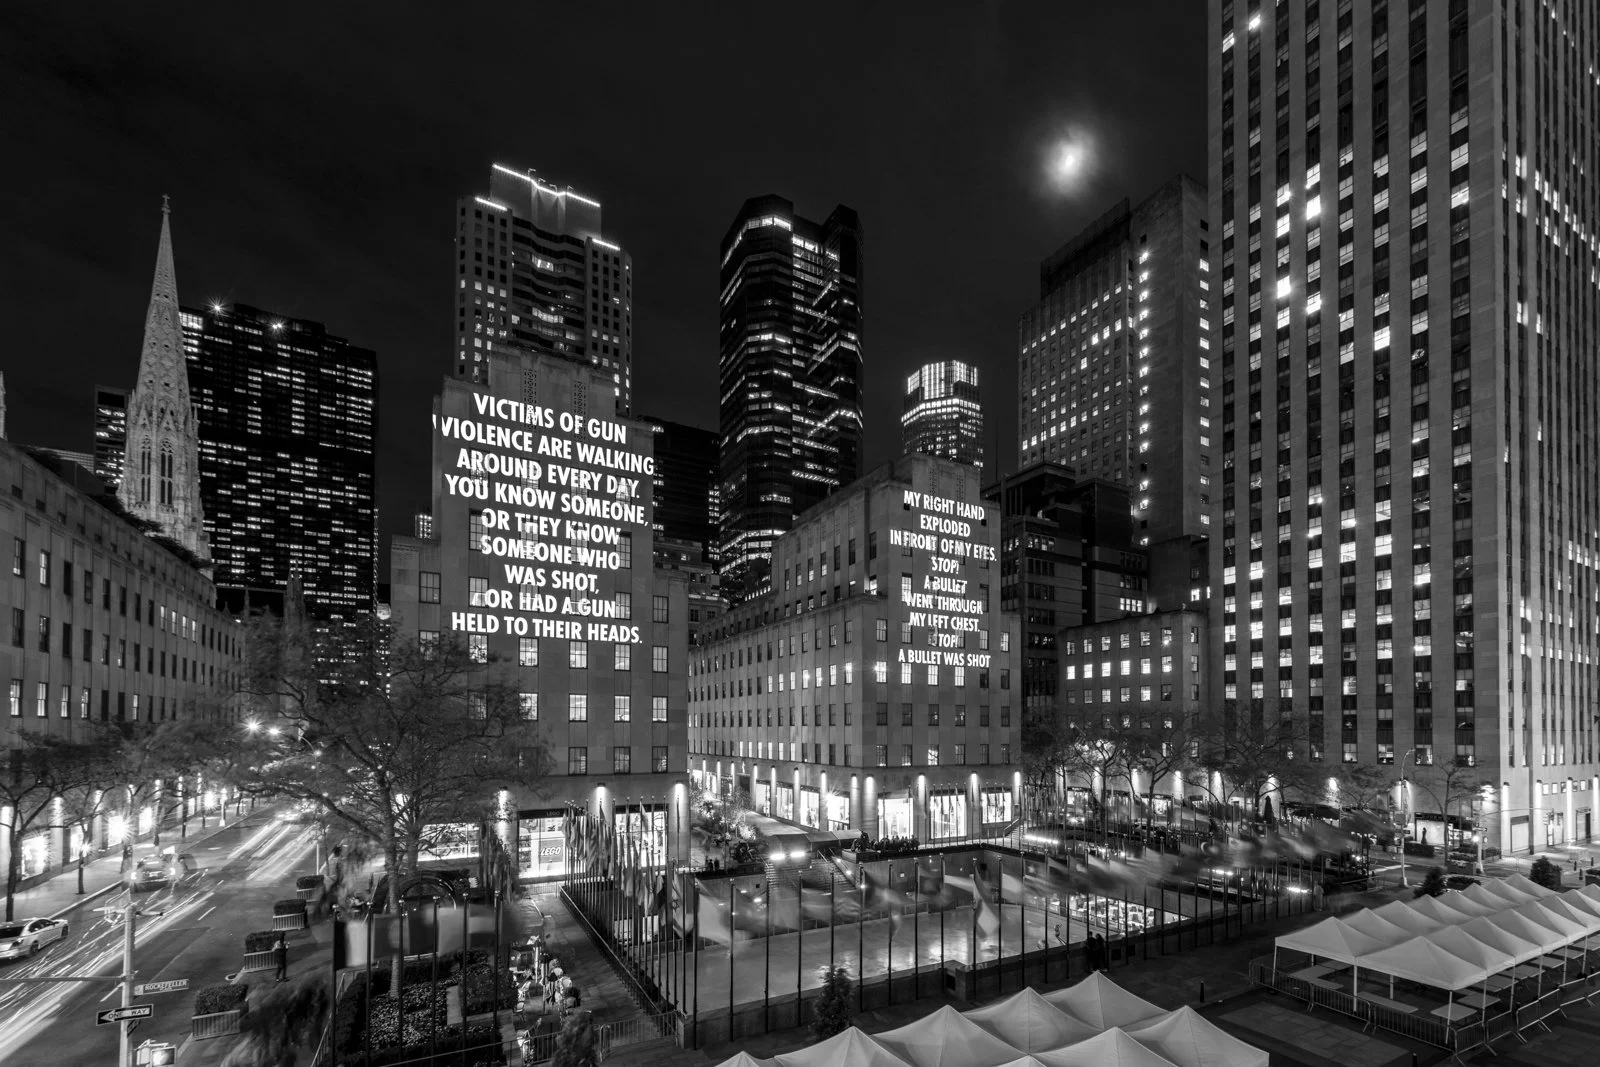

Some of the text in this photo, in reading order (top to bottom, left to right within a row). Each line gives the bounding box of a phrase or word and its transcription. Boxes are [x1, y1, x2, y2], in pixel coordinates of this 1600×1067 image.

[473, 392, 626, 444] VICTIMS OF GUN
[441, 416, 654, 475] VIOLENCE ARE WALKING
[456, 448, 640, 498] AROUND EVERY DAY.
[444, 474, 648, 526] YOU KNOW SOMEONE,
[904, 490, 984, 520] MY RIGHT HAND
[482, 508, 621, 546] OR THEY KNOW
[920, 514, 970, 538] EXPLODED
[481, 534, 620, 570] SOMEONE WHO
[890, 529, 902, 546] IN
[902, 531, 938, 551] FRONT
[940, 538, 954, 554] OF
[974, 544, 997, 562] EYES.
[504, 564, 600, 594] WAS SHOT,
[930, 556, 960, 574] STOP!
[924, 575, 968, 594] A BULLET
[484, 588, 616, 619] OR HAD A GUN
[904, 591, 984, 614] WENT THROUGH
[452, 611, 643, 644] HELD TO THEIR HEADS.
[910, 612, 980, 632] MY LEFT CHEST.
[898, 648, 991, 668] A BULLET WAS SHOT
[540, 846, 561, 856] LEGO
